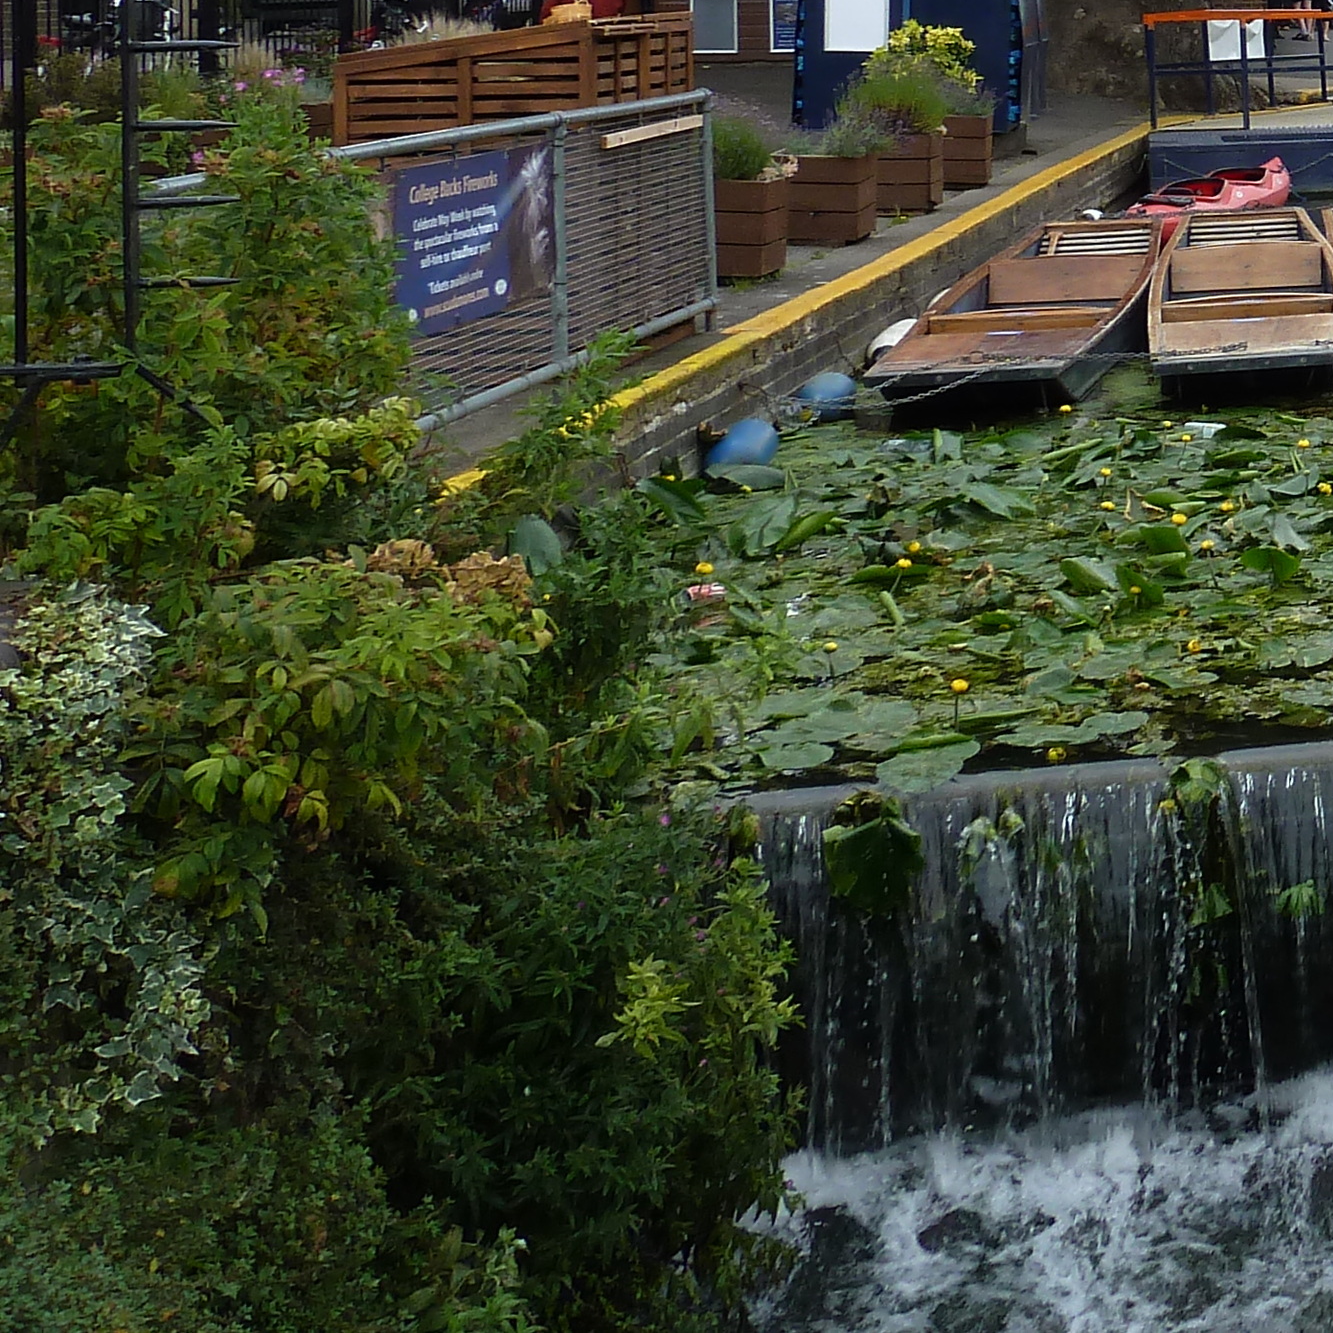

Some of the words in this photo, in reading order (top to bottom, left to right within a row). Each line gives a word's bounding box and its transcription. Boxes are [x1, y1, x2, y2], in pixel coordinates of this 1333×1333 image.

[410, 184, 439, 205] College
[463, 170, 498, 193] Fireworks
[427, 280, 450, 295] Tickets
